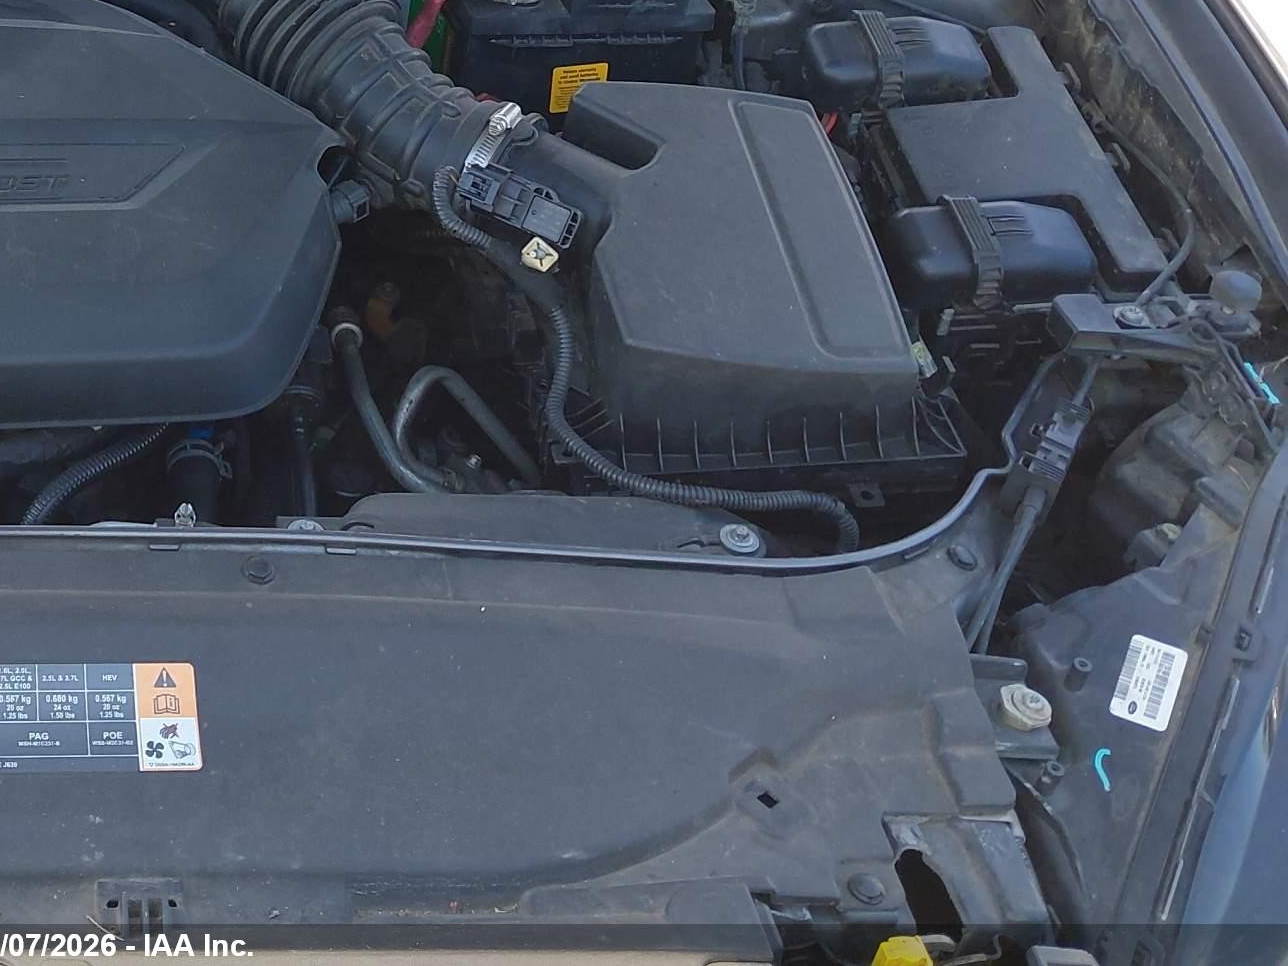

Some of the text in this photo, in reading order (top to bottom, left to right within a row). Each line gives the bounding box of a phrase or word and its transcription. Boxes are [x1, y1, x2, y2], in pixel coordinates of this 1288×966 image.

[102, 674, 117, 682] HEV
[21, 694, 32, 705] kg
[68, 694, 79, 705] kg
[116, 694, 127, 704] kg
[28, 732, 50, 741] PAG
[103, 731, 124, 740] POE
